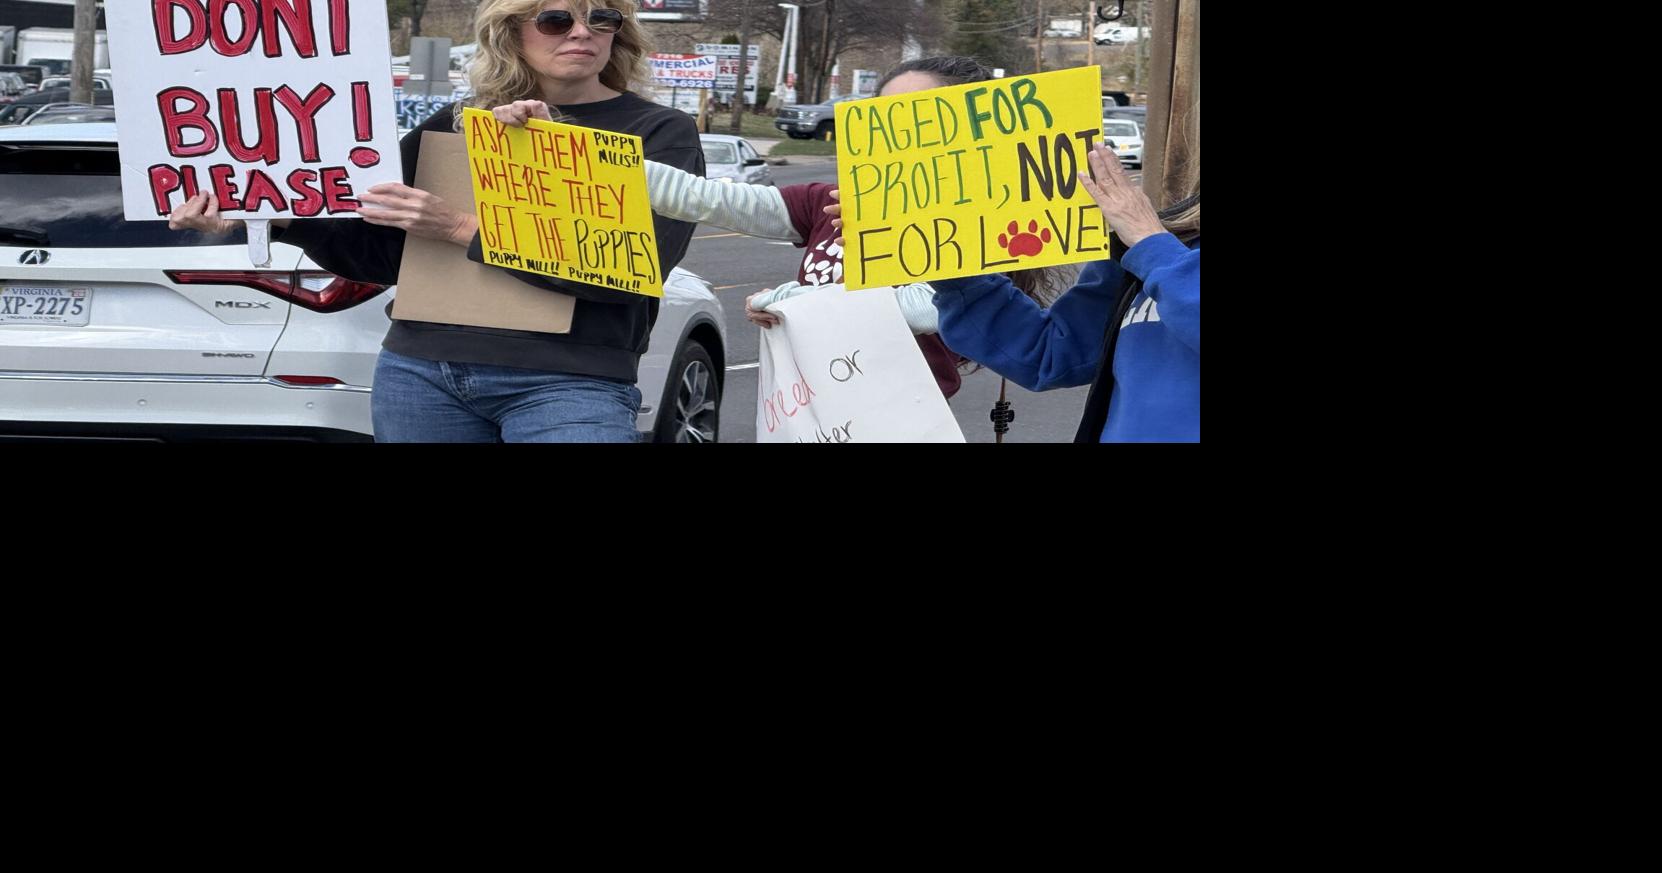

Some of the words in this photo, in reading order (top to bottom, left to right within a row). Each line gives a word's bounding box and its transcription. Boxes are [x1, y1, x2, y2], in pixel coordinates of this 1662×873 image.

[669, 69, 713, 78] TRUCKS
[156, 82, 380, 168] BUY!
[845, 96, 958, 157] CAGED
[965, 78, 1053, 141] FOR
[472, 116, 512, 159] ASK
[525, 127, 592, 181] THEM
[850, 145, 1010, 222] PROFIT,
[1017, 128, 1100, 202] NOT
[148, 163, 362, 216] PLEASE
[473, 157, 557, 208] WHERE
[562, 179, 625, 224] THEY
[480, 201, 519, 253] GET
[525, 212, 570, 262] THE
[574, 219, 656, 284] PUPPIES
[488, 251, 523, 268] PUPPY
[526, 259, 560, 275] MILL!!
[568, 267, 603, 284] PUPPY
[606, 275, 641, 293] MILL!!
[858, 217, 962, 285] FOR
[1, 296, 85, 315] XP-2275
[11, 288, 63, 296] VIRGINIA
[215, 301, 271, 309] MDX
[829, 349, 863, 382] or
